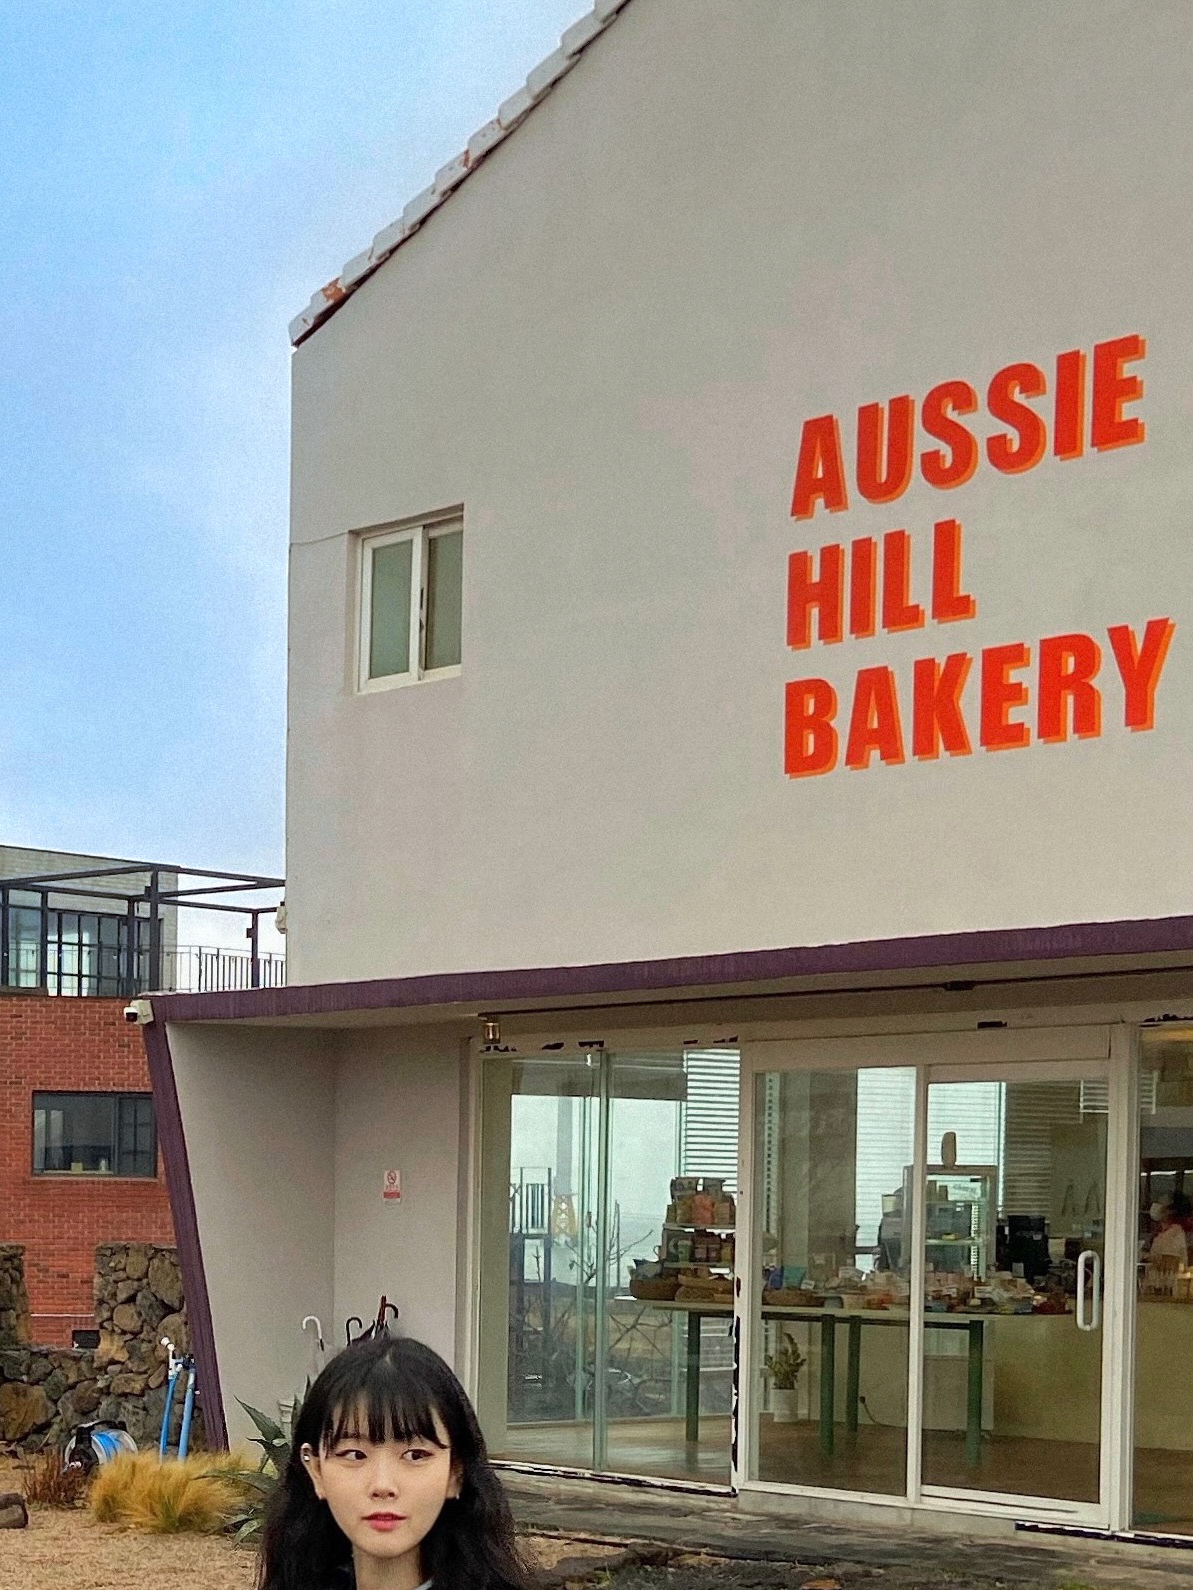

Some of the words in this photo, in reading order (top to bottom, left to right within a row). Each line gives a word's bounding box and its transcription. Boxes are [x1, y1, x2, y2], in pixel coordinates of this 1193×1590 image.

[790, 334, 1147, 521] AUSSIE
[786, 518, 977, 651] HILL
[784, 617, 1175, 779] BAKERY
